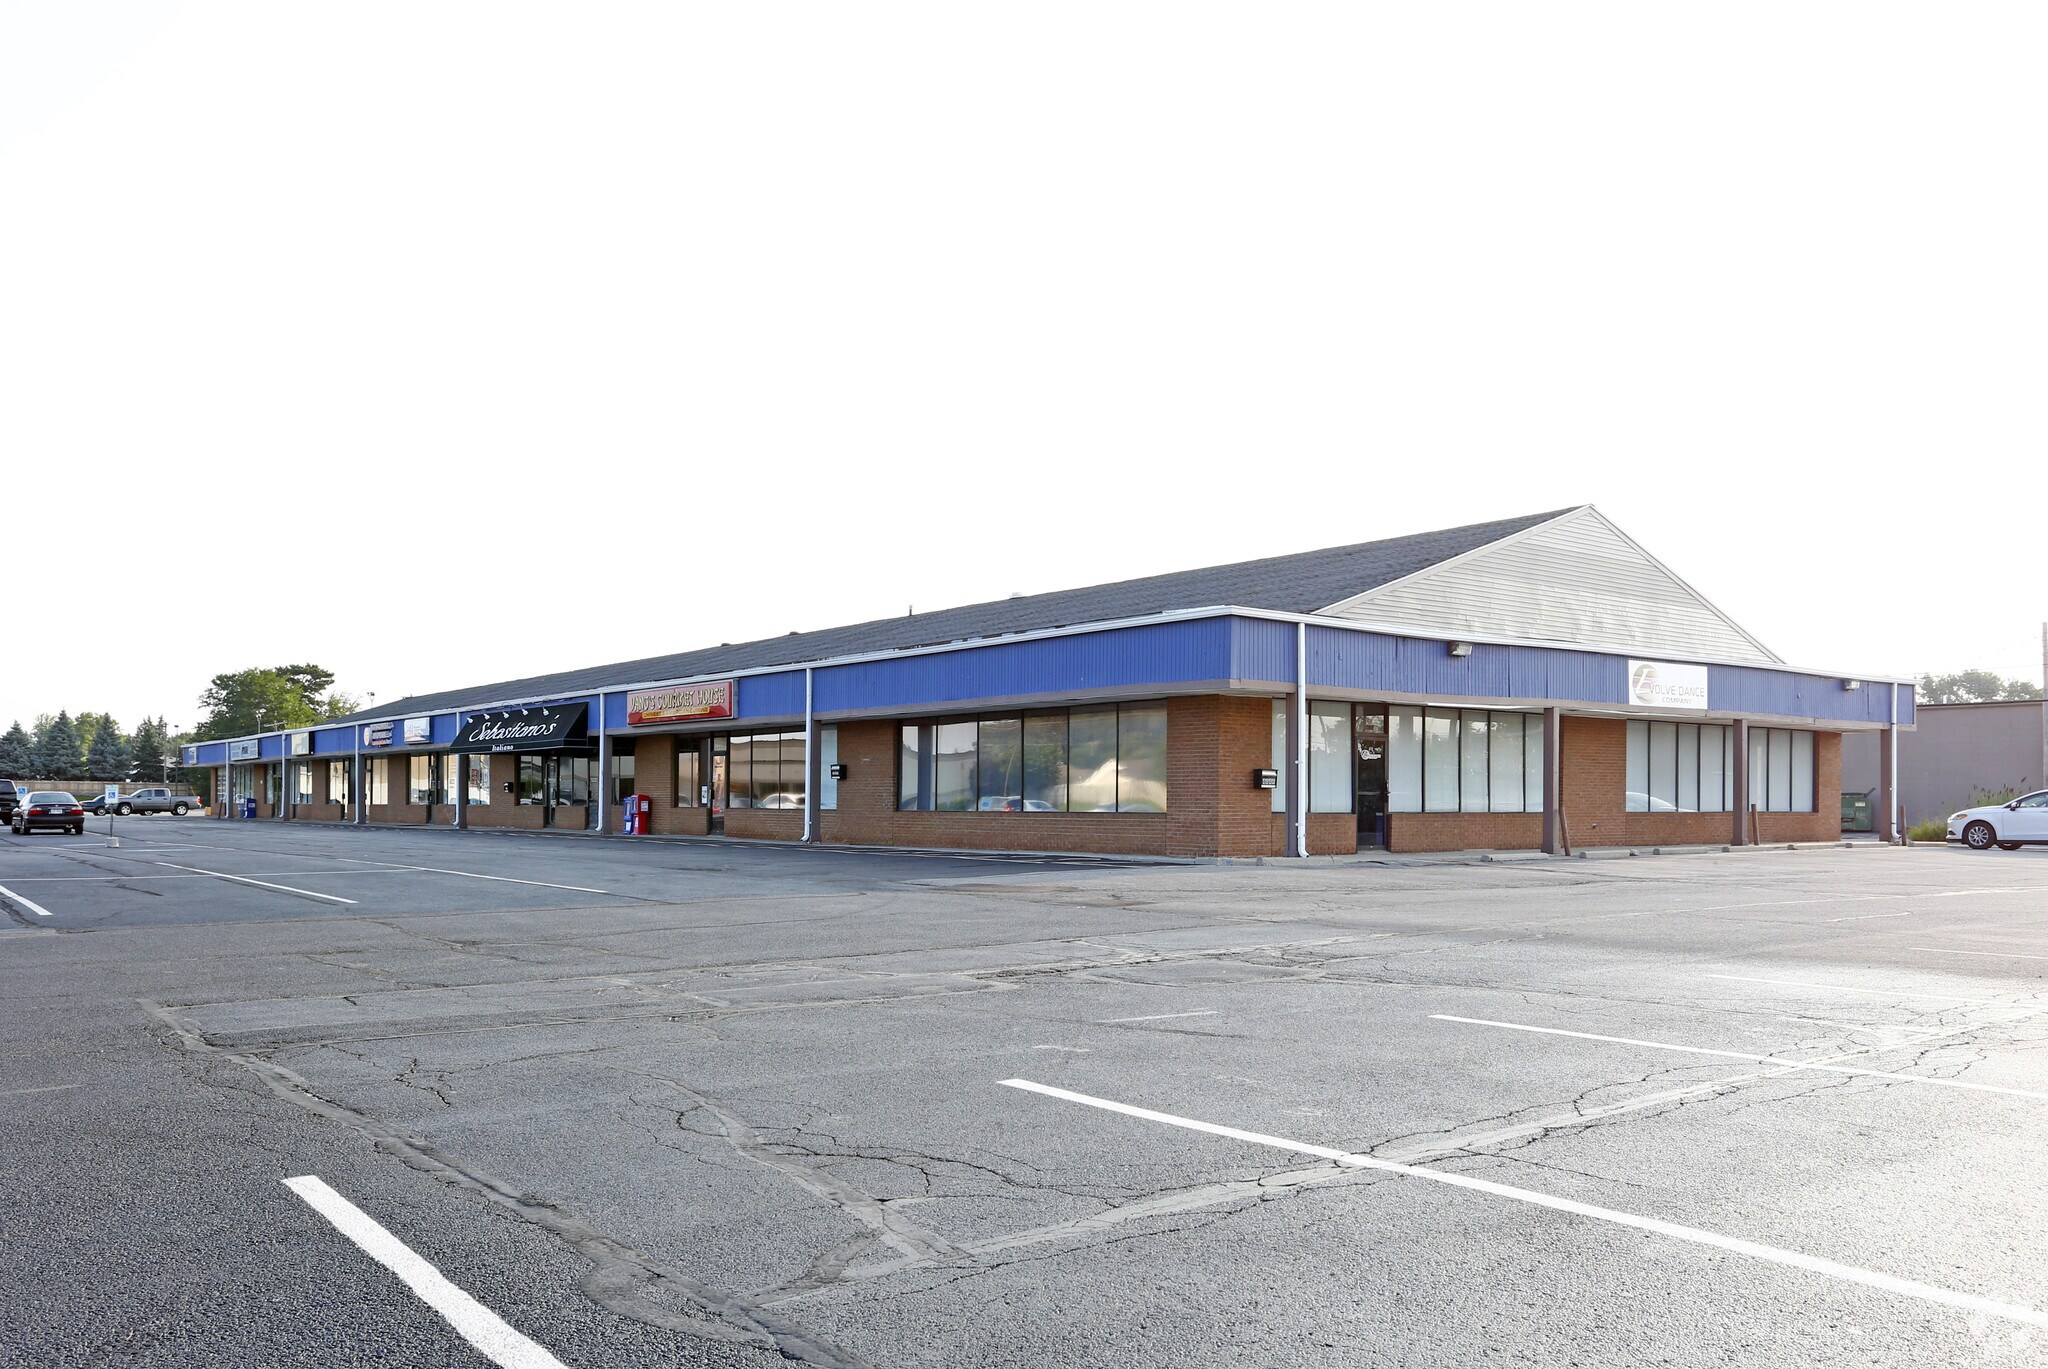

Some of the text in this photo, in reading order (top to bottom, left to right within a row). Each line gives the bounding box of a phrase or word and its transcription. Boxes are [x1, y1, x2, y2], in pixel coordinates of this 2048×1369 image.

[658, 691, 695, 709] GOURMET
[697, 687, 724, 705] HOUSE
[1679, 686, 1705, 697] DANCE
[1662, 697, 1692, 705] COMPANY
[468, 714, 560, 742] Sebastiano's
